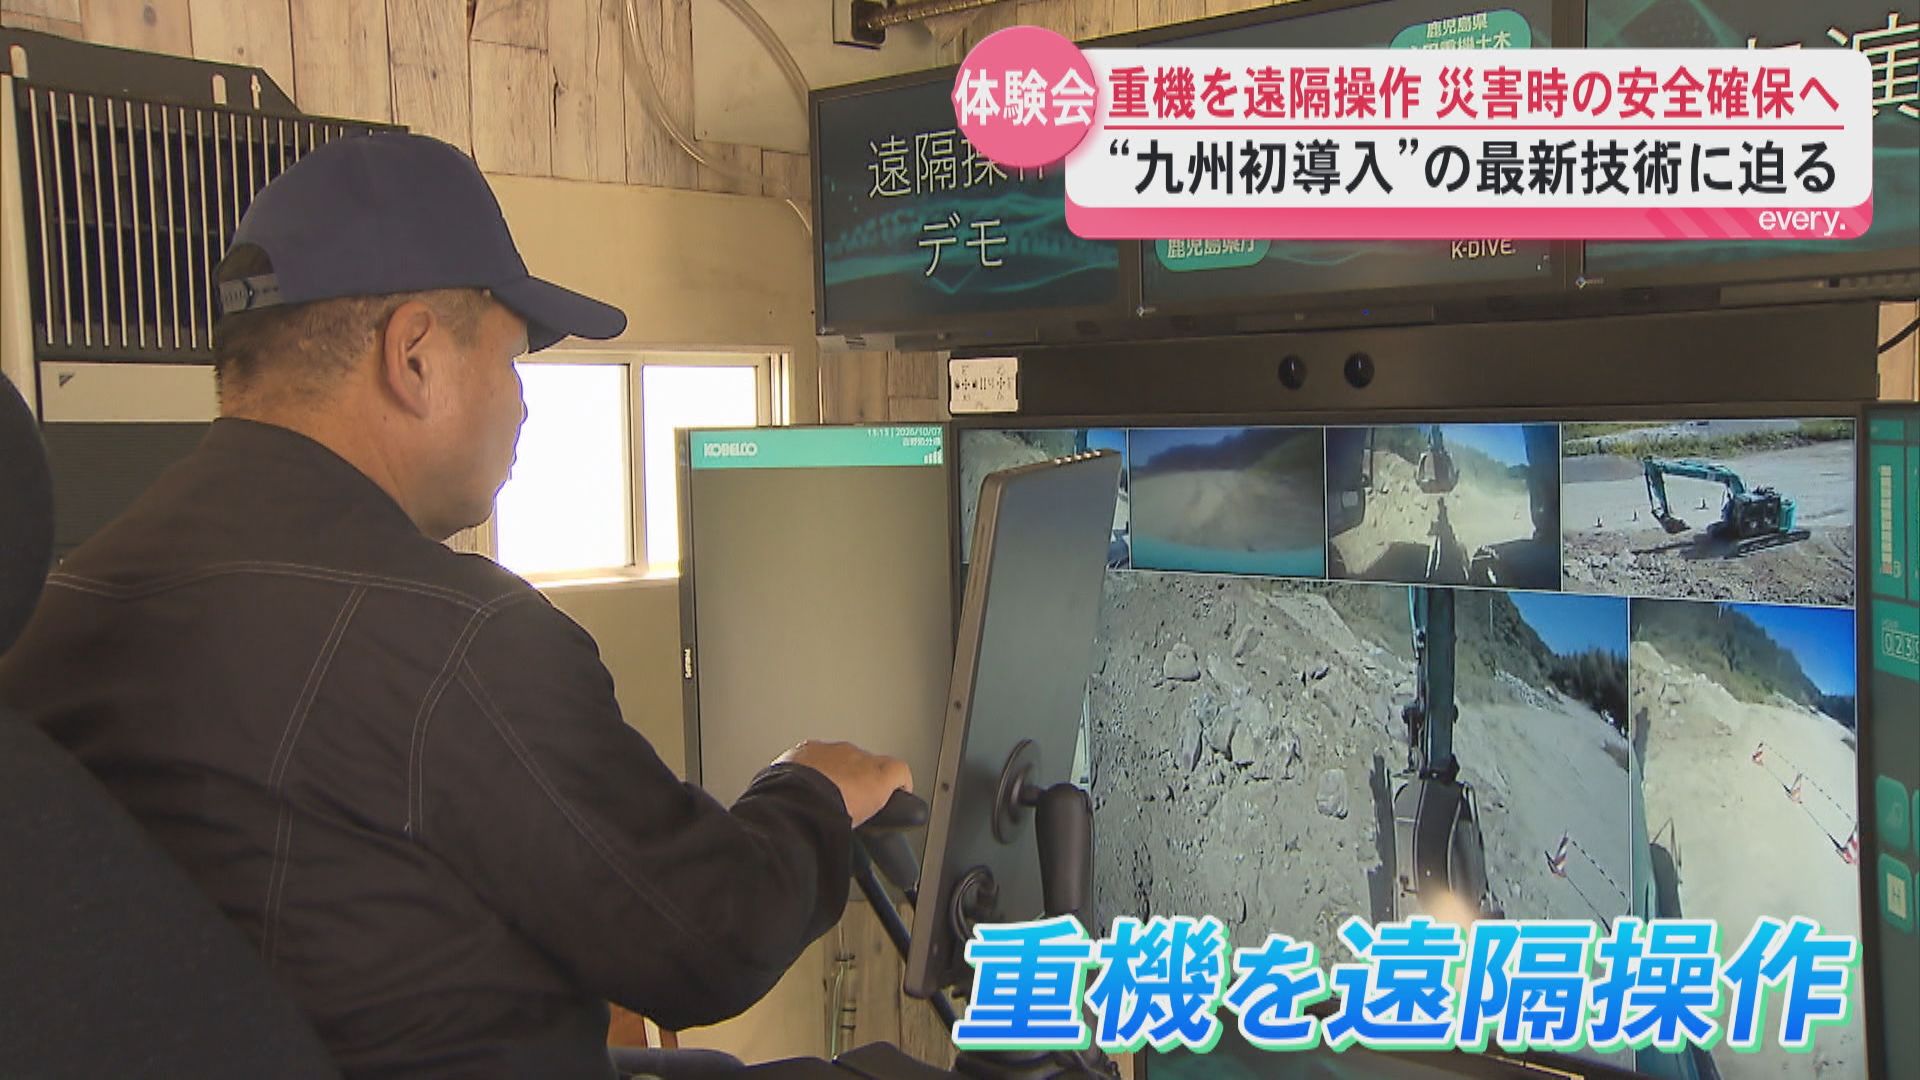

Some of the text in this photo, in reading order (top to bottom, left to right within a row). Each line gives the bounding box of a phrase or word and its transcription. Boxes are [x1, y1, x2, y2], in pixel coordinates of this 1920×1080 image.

[1426, 12, 1489, 38] 鹿児島県
[918, 212, 1007, 277] デモ
[703, 442, 758, 457] KOBELCO
